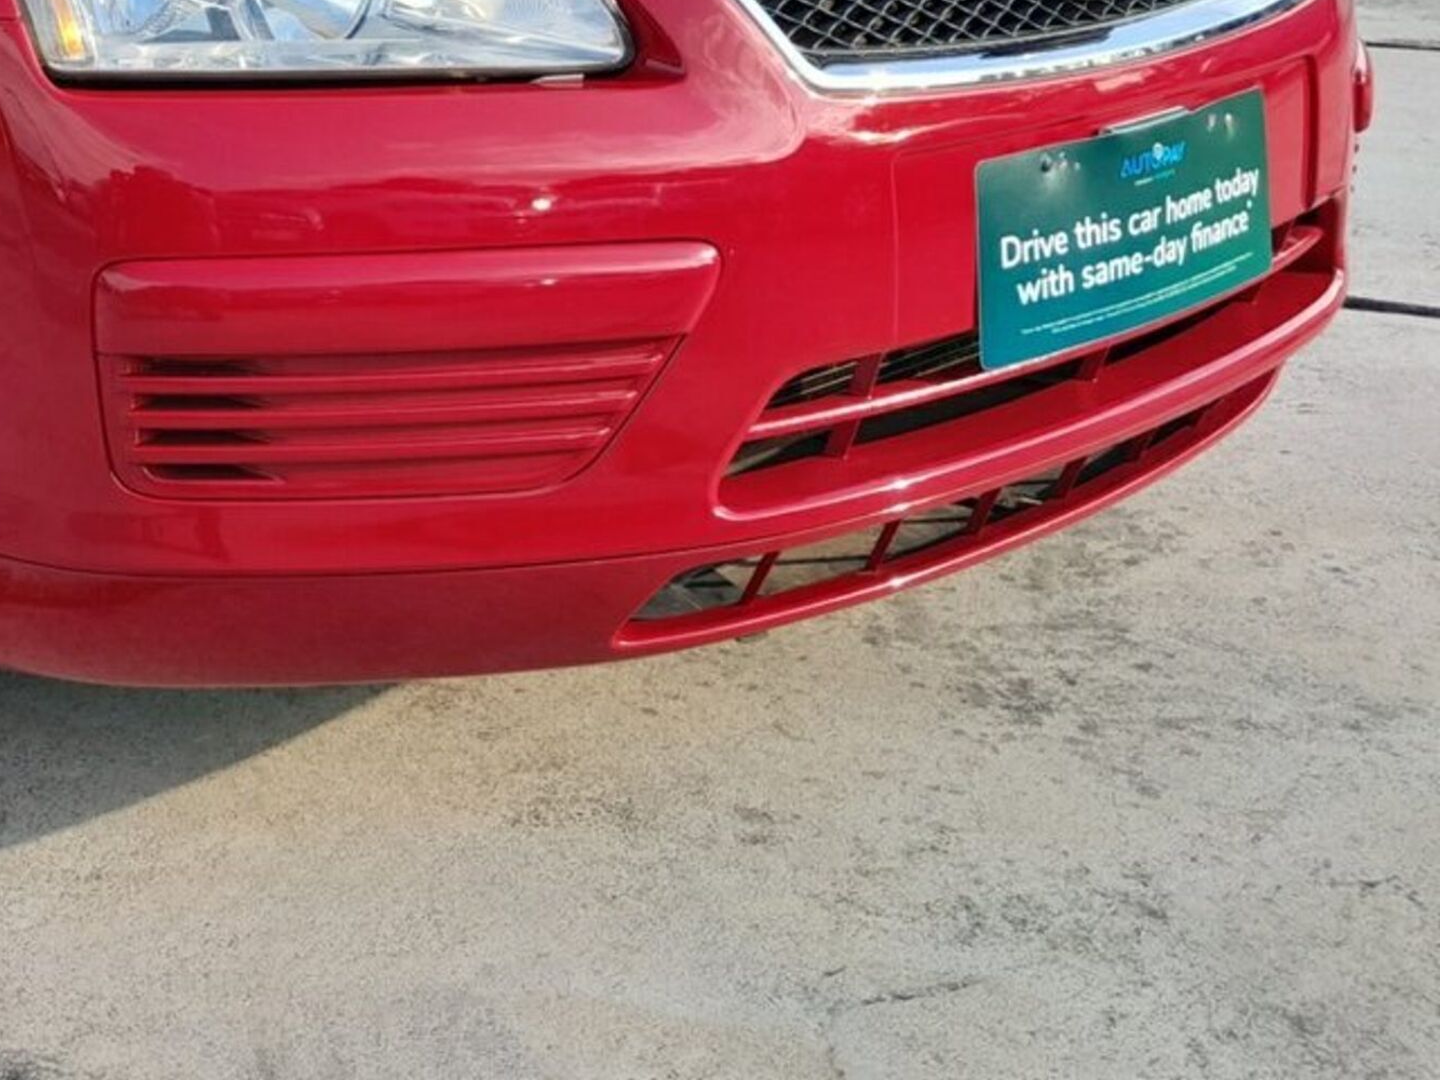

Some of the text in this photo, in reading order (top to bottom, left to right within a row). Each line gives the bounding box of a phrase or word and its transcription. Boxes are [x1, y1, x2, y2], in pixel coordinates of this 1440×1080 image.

[1000, 228, 1069, 269] Drive
[1074, 212, 1122, 249] this
[1128, 205, 1162, 236] car
[1165, 185, 1213, 224] home
[1215, 167, 1260, 204] today
[1016, 263, 1075, 305] with
[1082, 235, 1188, 289] same-day
